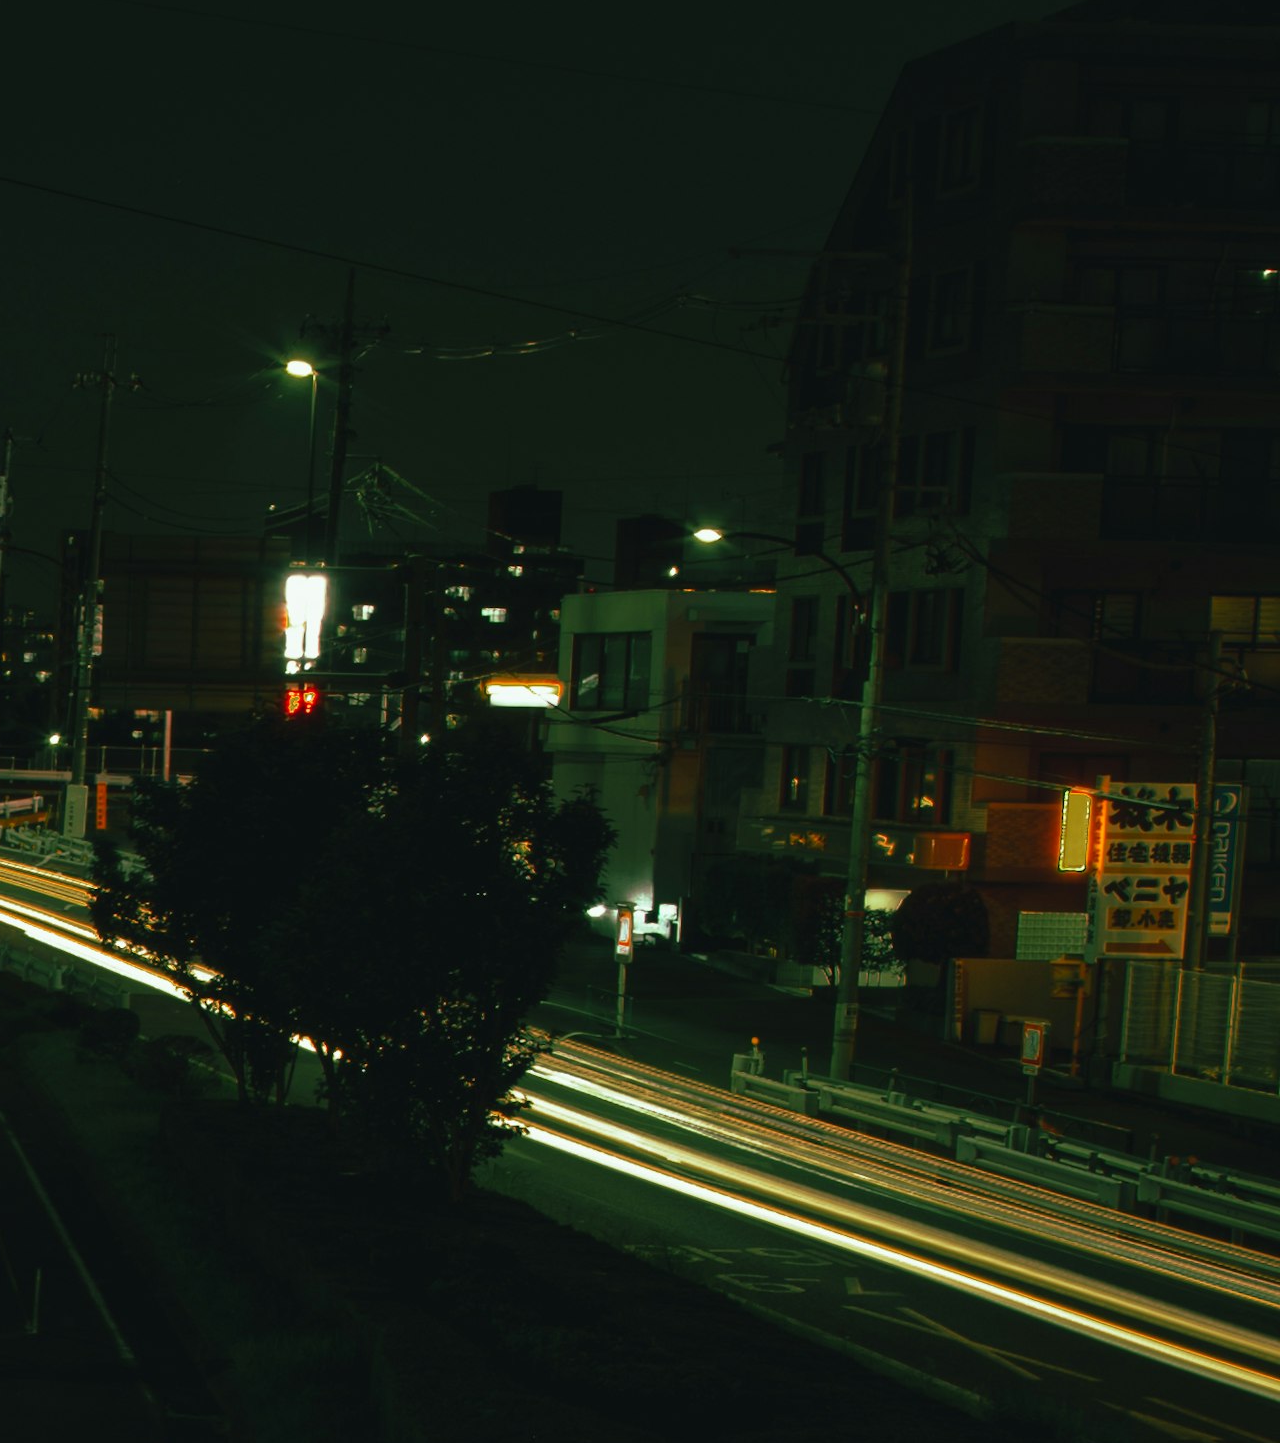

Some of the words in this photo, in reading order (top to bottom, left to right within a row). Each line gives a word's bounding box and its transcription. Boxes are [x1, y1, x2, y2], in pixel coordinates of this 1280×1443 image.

[1106, 842, 1191, 864] 住宅機器
[1104, 876, 1189, 905] ベニヤ
